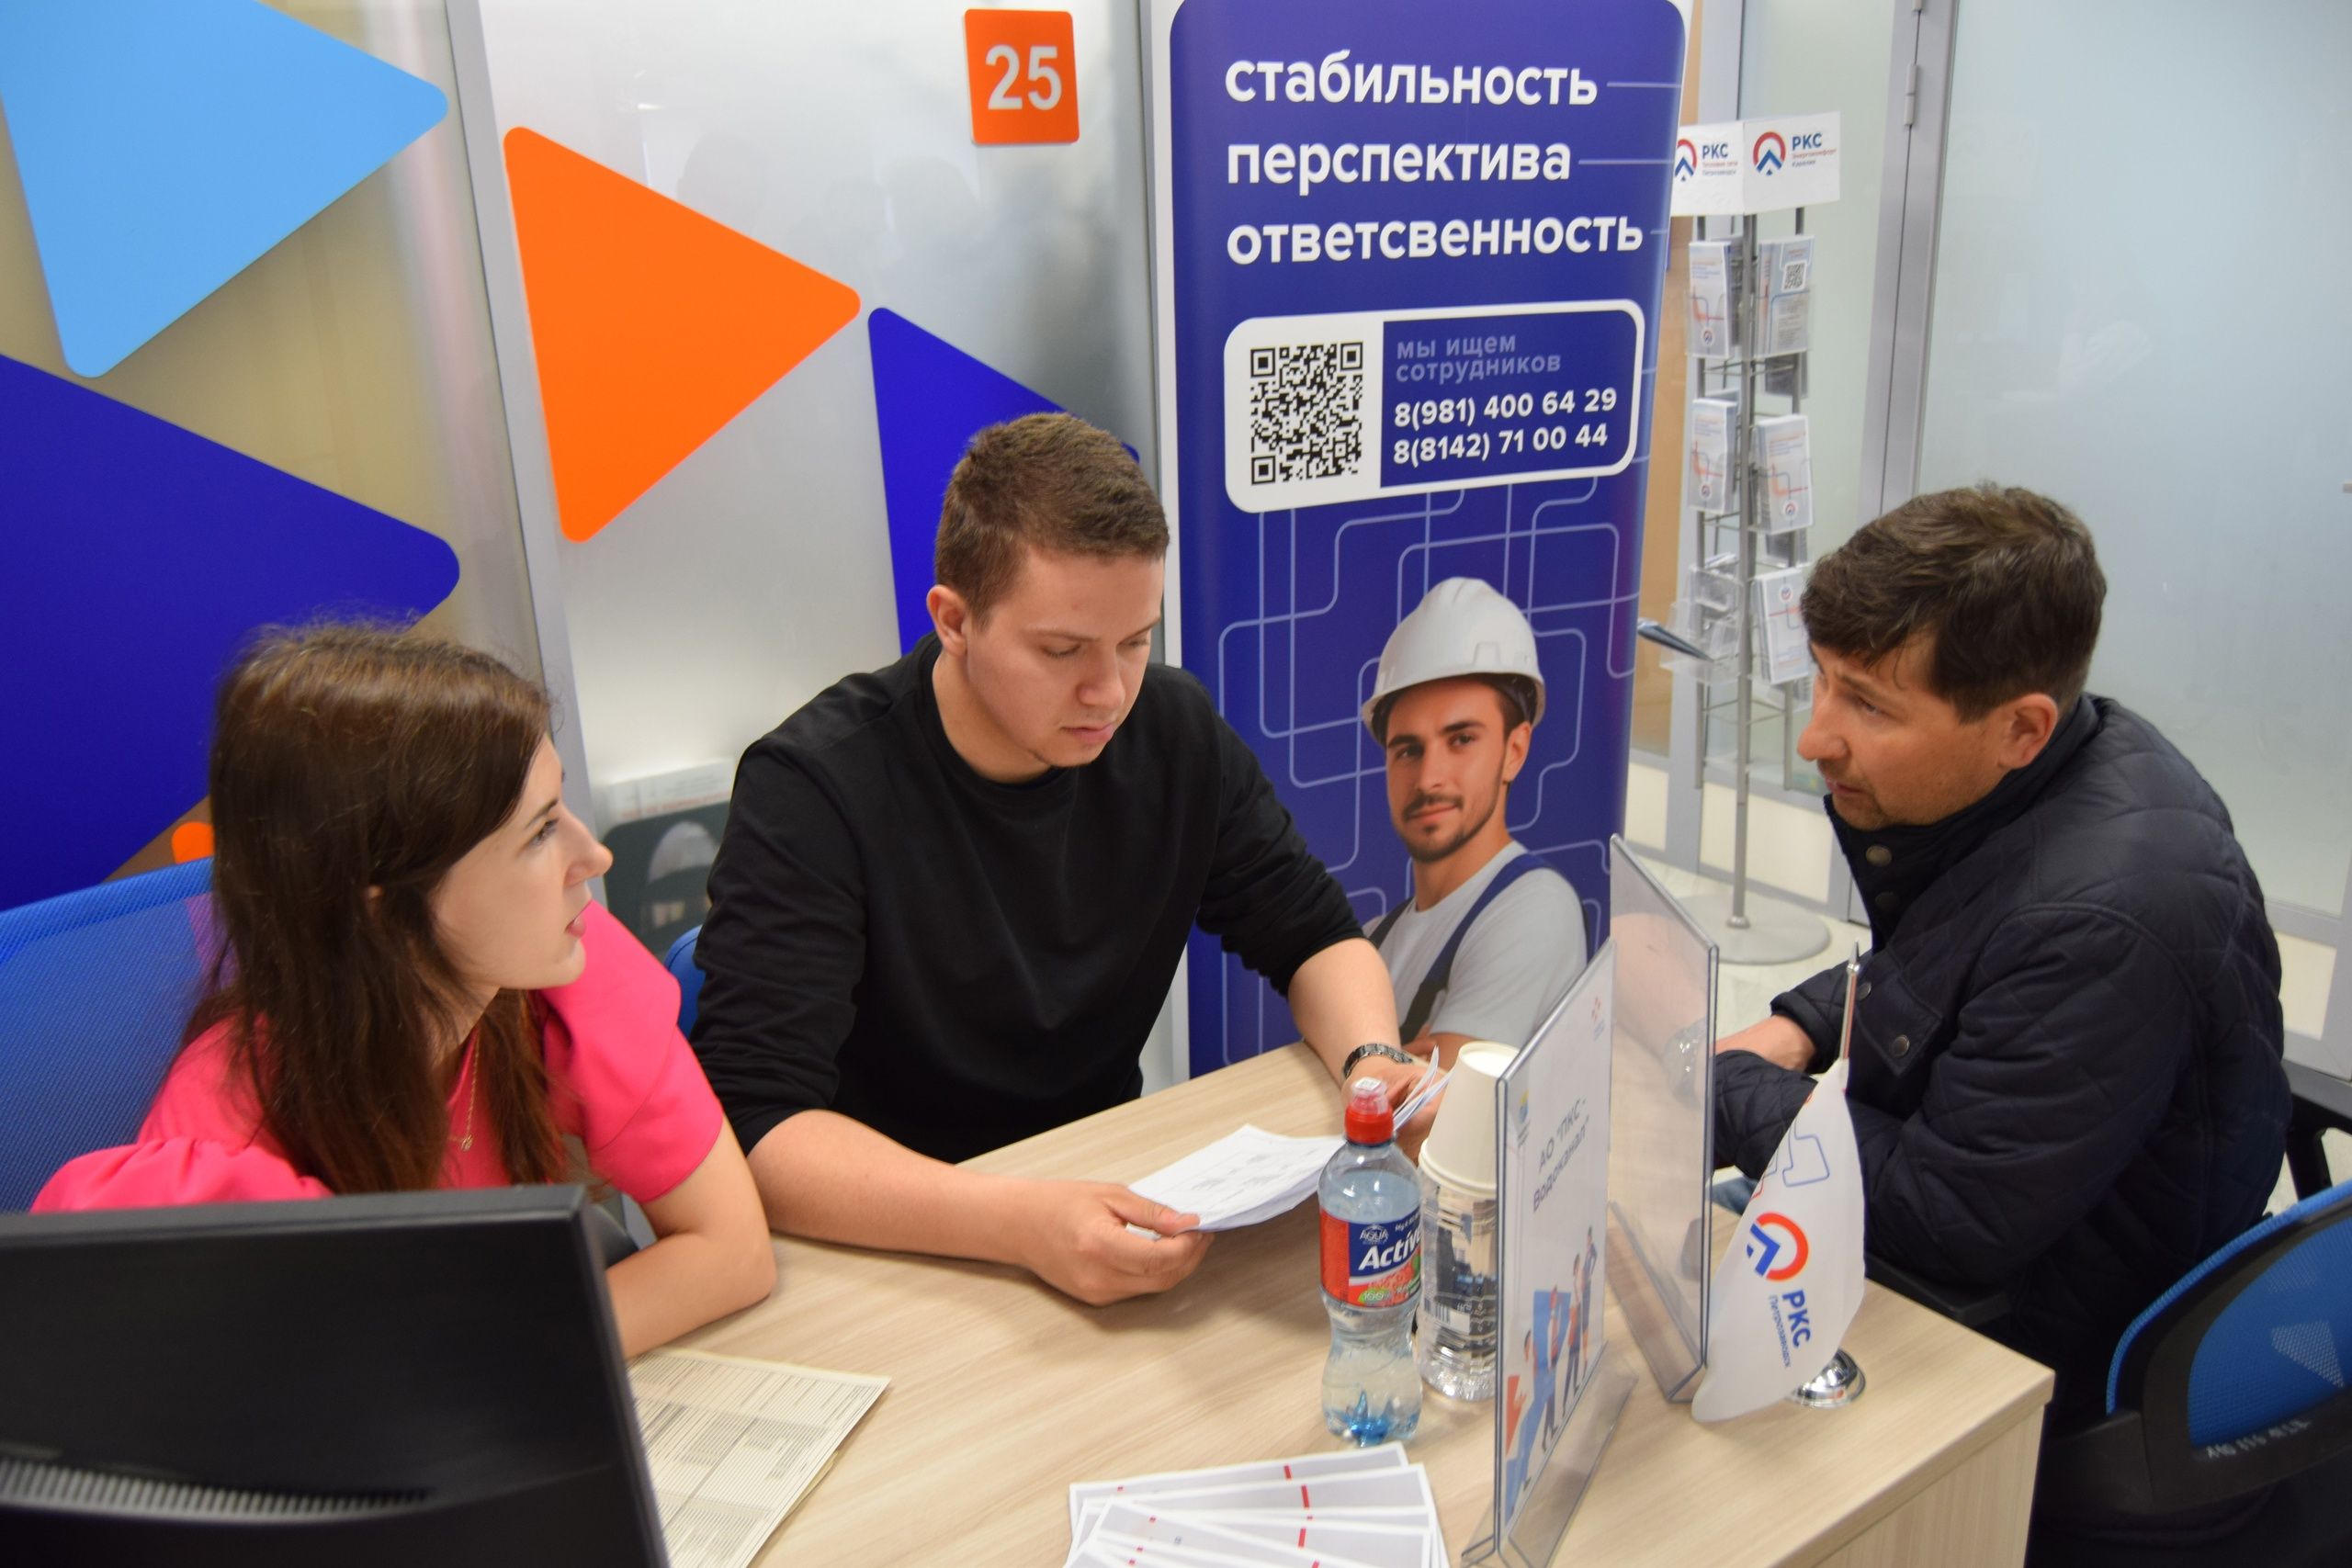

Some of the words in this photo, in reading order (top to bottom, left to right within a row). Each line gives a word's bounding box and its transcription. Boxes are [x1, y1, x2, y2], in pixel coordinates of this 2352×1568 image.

[985, 44, 1062, 111] 25
[1225, 49, 1598, 106] стабильность
[1702, 143, 1728, 159] РКС
[1792, 133, 1822, 151] РКС
[1227, 141, 1571, 196] перспектива
[1227, 216, 1643, 265] ответсвенность
[1396, 341, 1435, 359] мы
[1446, 335, 1516, 357] ищем
[1396, 355, 1561, 385] сотрудников
[1394, 398, 1476, 432] 8(981)
[1484, 392, 1533, 420] 400
[1542, 389, 1576, 414] 64
[1584, 387, 1617, 412] 29
[1393, 432, 1490, 468] 8(8142)
[1498, 429, 1524, 454] 71
[1532, 425, 1567, 451] 00
[1575, 423, 1608, 447] 44
[1782, 1290, 1811, 1348] РКС
